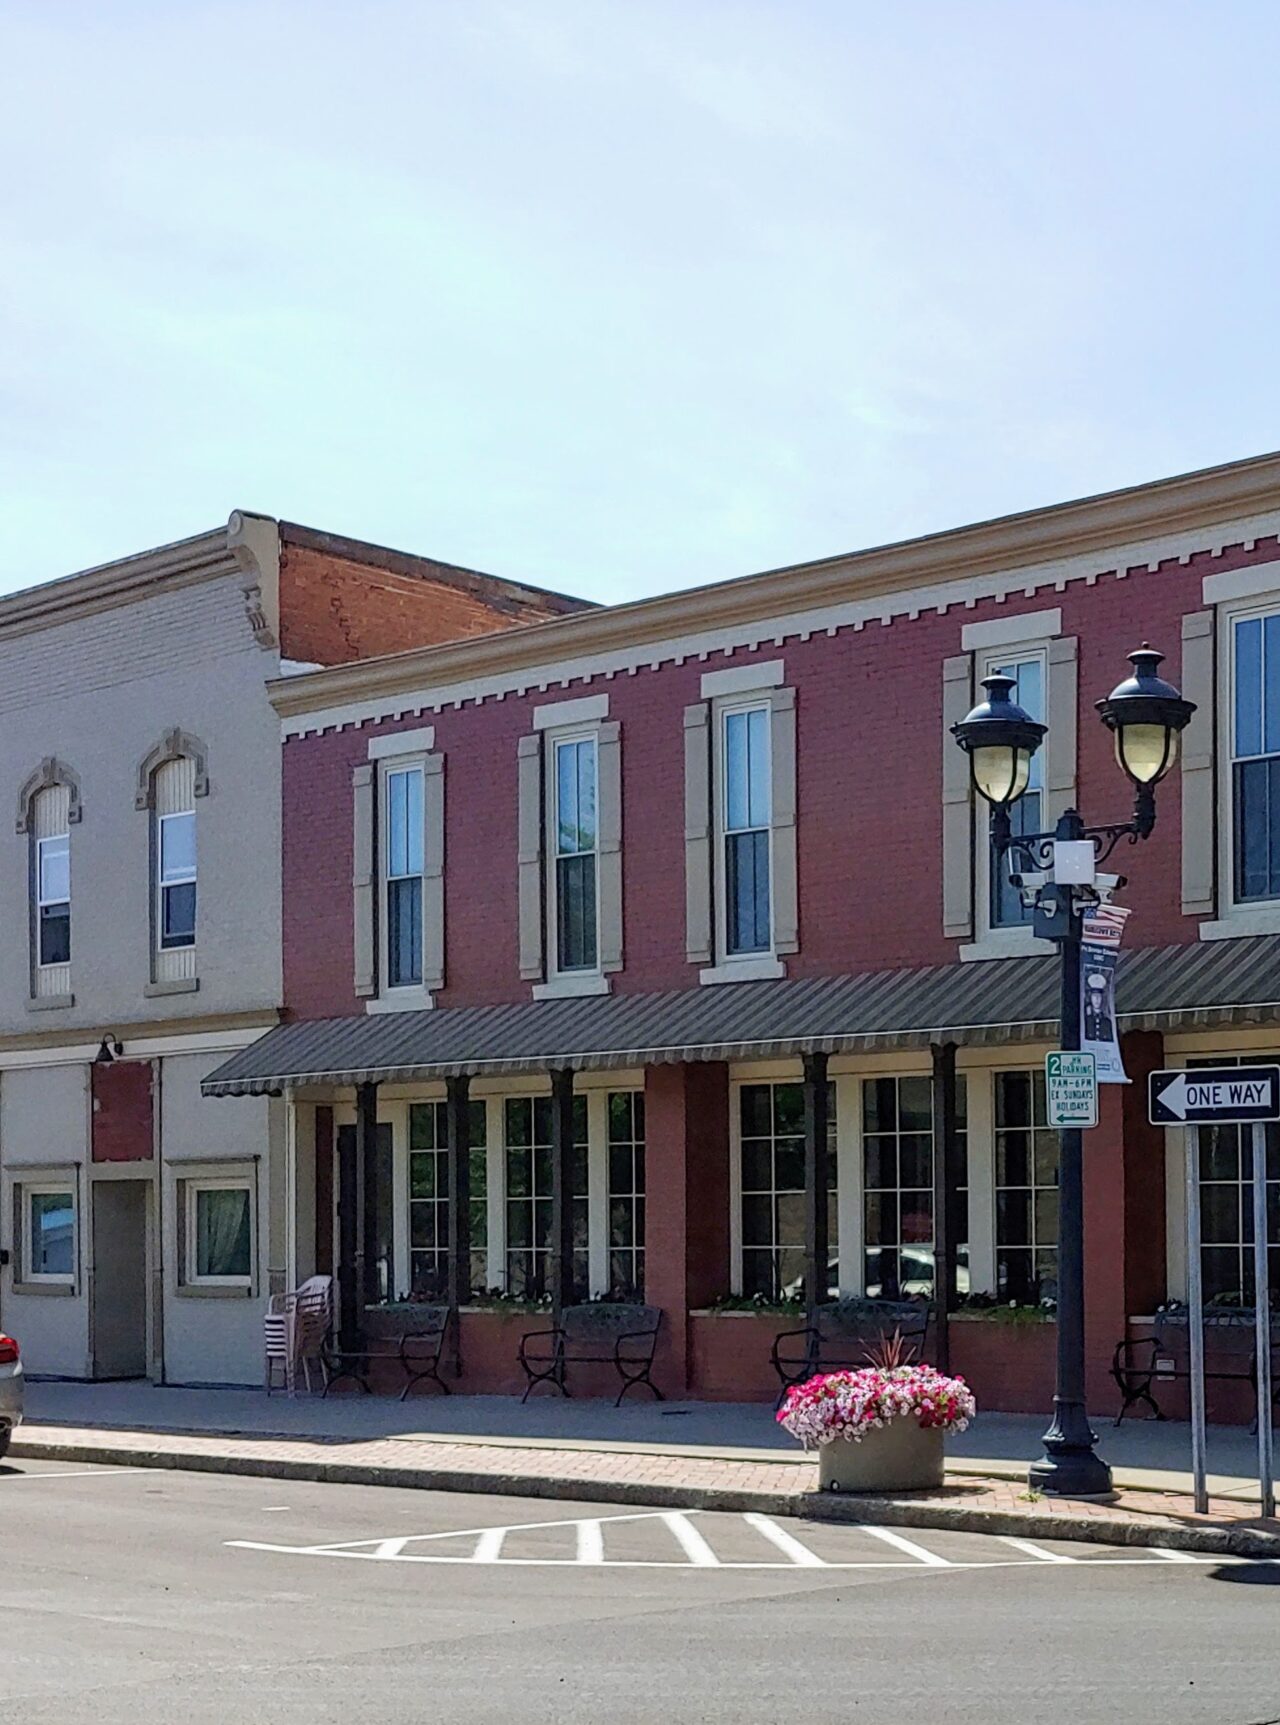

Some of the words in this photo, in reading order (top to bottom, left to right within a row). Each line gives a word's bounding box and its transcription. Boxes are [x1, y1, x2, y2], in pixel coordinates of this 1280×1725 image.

[1050, 1056, 1060, 1075] 2
[1062, 1065, 1092, 1074] PARKING
[1064, 1089, 1093, 1100] SUNDAYS
[1186, 1085, 1222, 1106] ONE
[1229, 1083, 1266, 1105] WAY
[1056, 1102, 1089, 1111] HOLIDAYS
